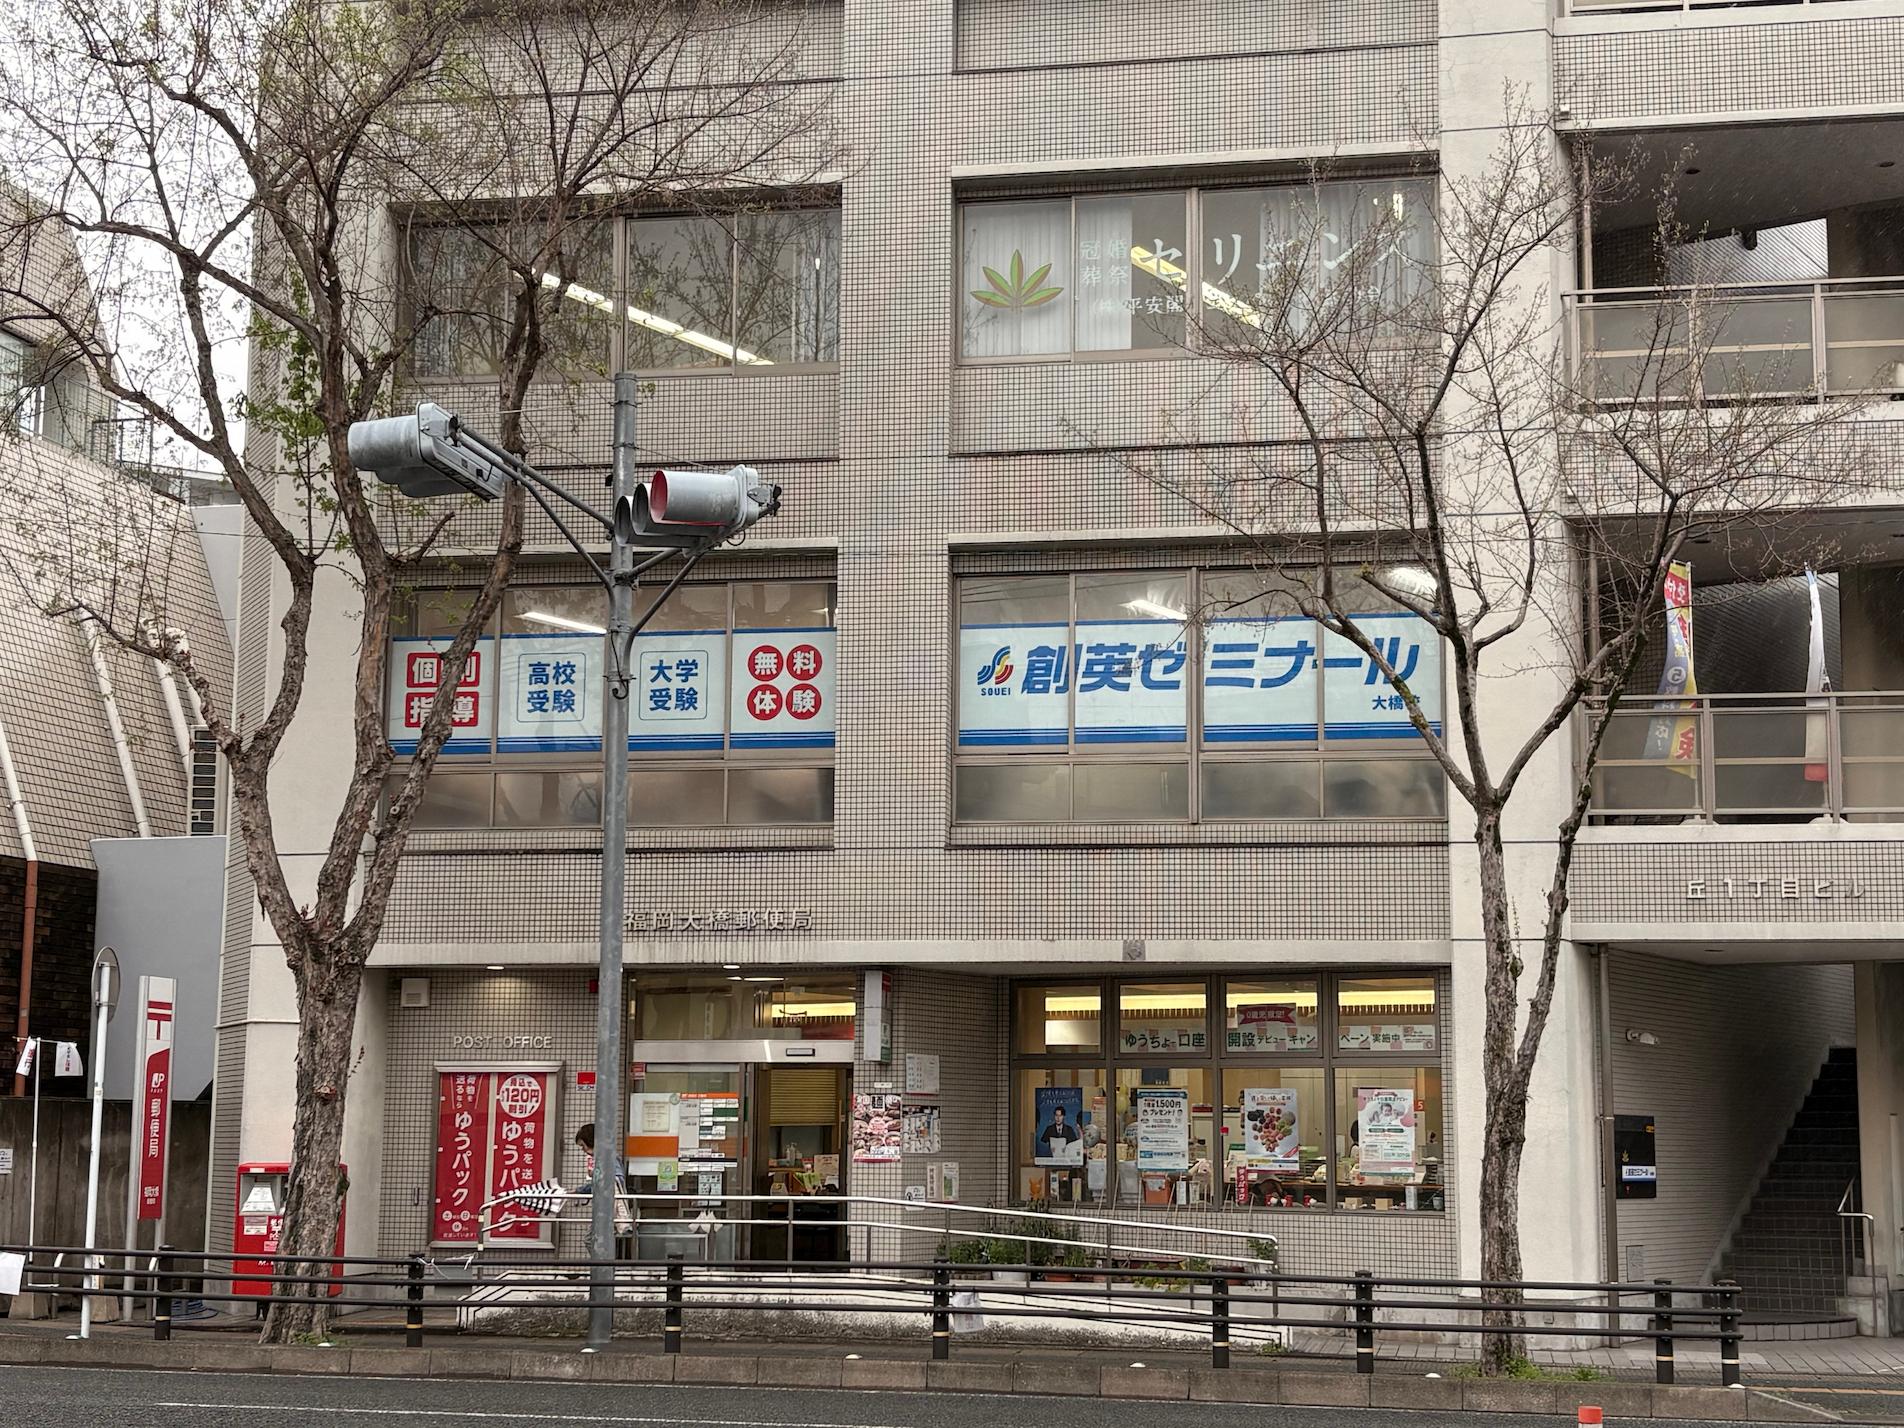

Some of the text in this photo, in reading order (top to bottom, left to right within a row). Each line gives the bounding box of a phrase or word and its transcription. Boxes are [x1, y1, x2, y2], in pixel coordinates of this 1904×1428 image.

[528, 660, 576, 685] 高校
[650, 659, 698, 683] 大学
[753, 649, 817, 675] 無料
[1021, 637, 1420, 695] 創英ゼミナール
[527, 689, 575, 713] 受験
[649, 687, 698, 712] 受験
[753, 689, 817, 714] 体験
[980, 687, 1011, 696] SOUEI
[1372, 695, 1421, 710] 大橋
[624, 907, 813, 931] 福岡大橋郵便局
[453, 1035, 553, 1049] POST OFFICE
[505, 1088, 540, 1103] 120円
[1417, 1101, 1424, 1110] 5
[452, 1111, 473, 1206] ゆうパック
[498, 1121, 521, 1232] ゆうパク
